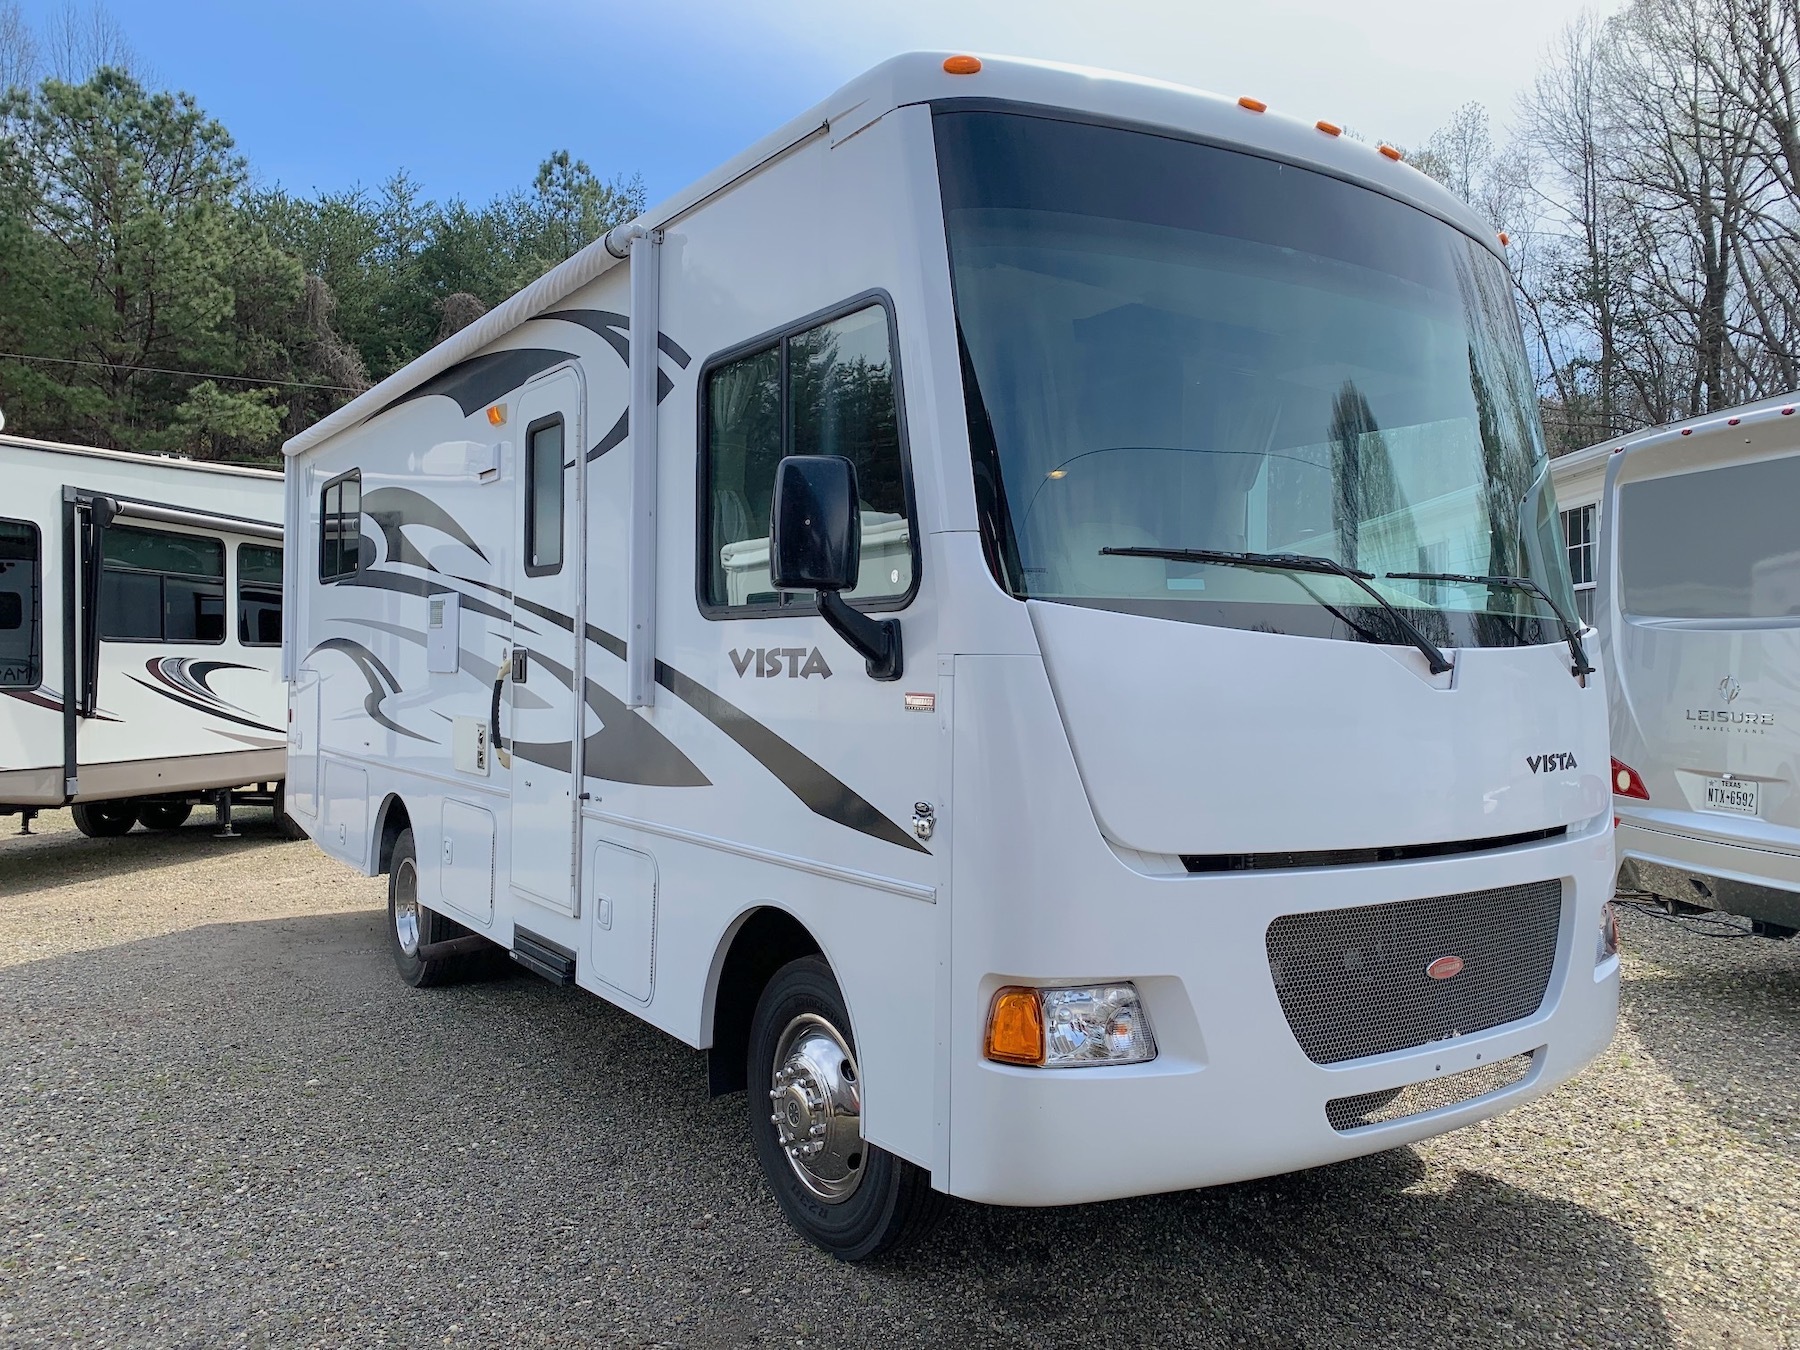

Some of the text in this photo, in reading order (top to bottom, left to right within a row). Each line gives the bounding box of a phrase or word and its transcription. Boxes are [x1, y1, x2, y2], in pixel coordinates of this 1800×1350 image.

[728, 646, 833, 680] VISTA
[1686, 709, 1774, 726] LEISURE
[1526, 752, 1578, 774] VISTA
[1721, 780, 1742, 789] TEXAS
